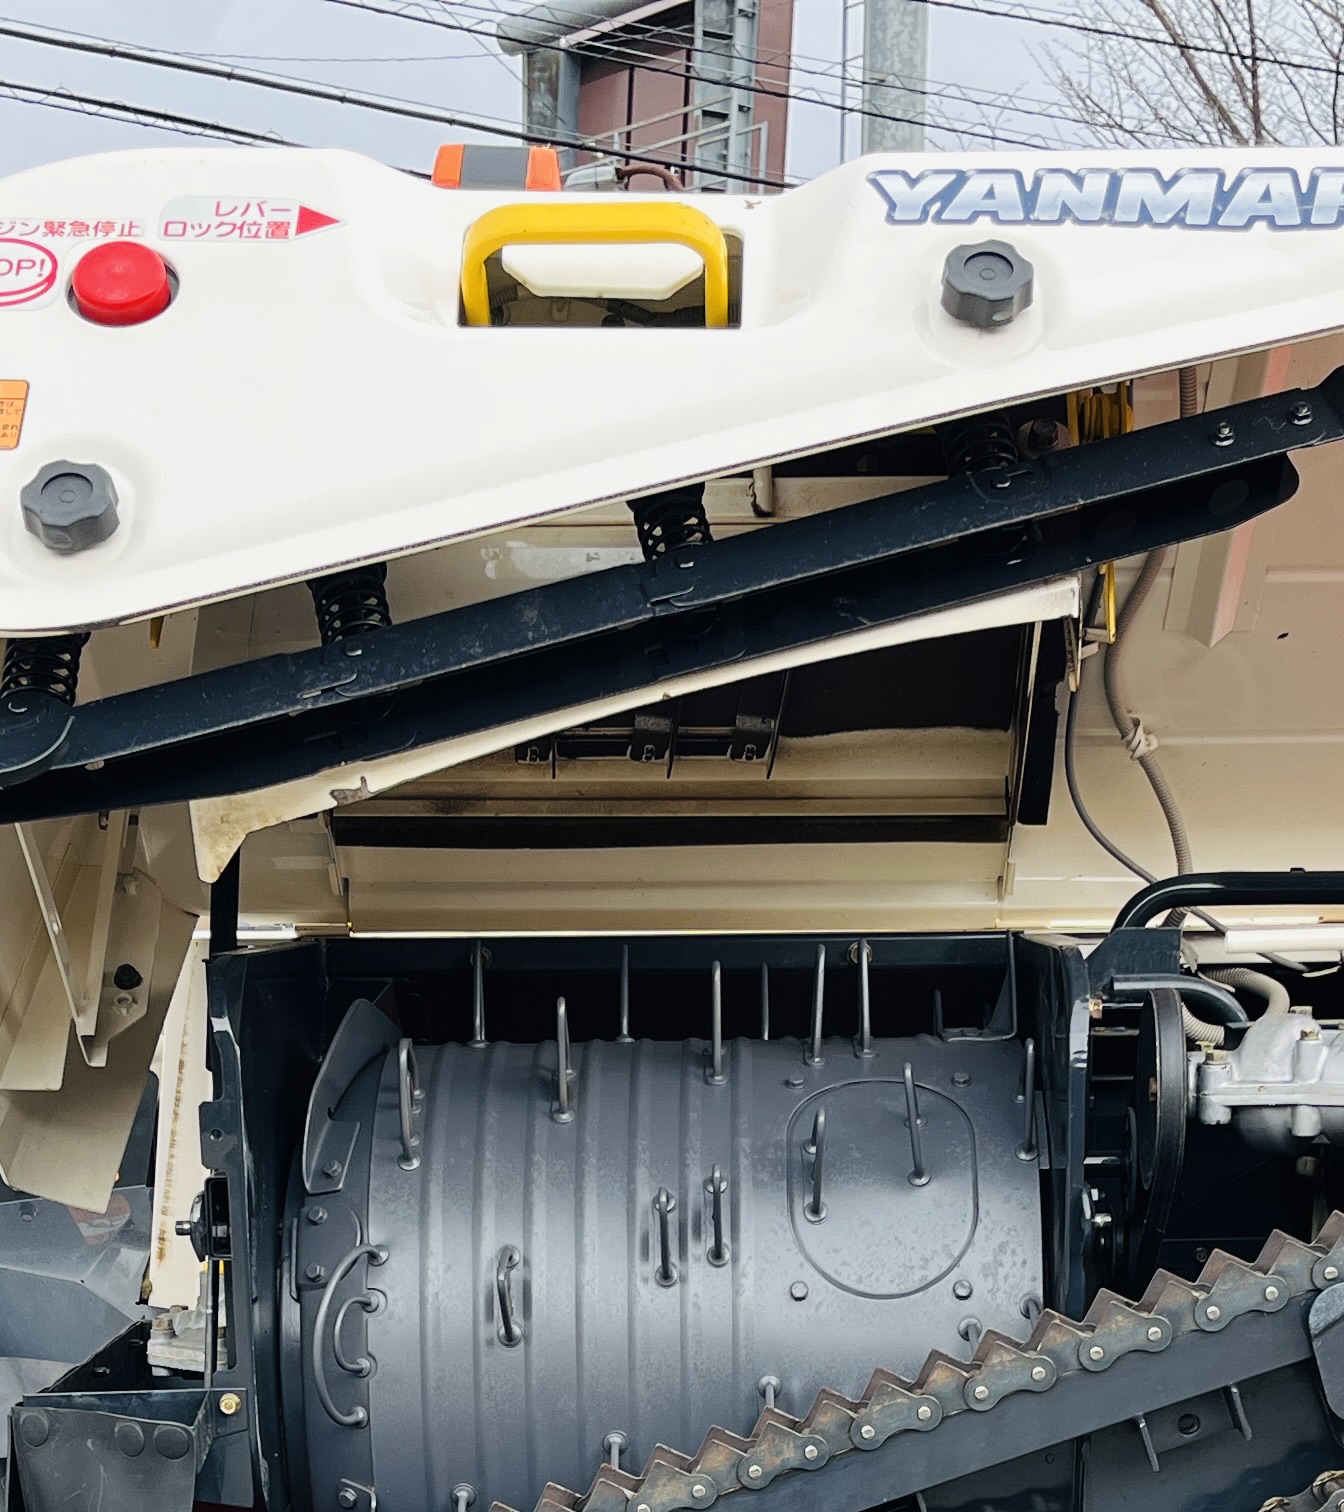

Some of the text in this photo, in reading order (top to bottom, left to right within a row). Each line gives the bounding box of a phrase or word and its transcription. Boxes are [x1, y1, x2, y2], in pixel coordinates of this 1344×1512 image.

[215, 201, 292, 217] レバー
[163, 220, 291, 239] ロック位置
